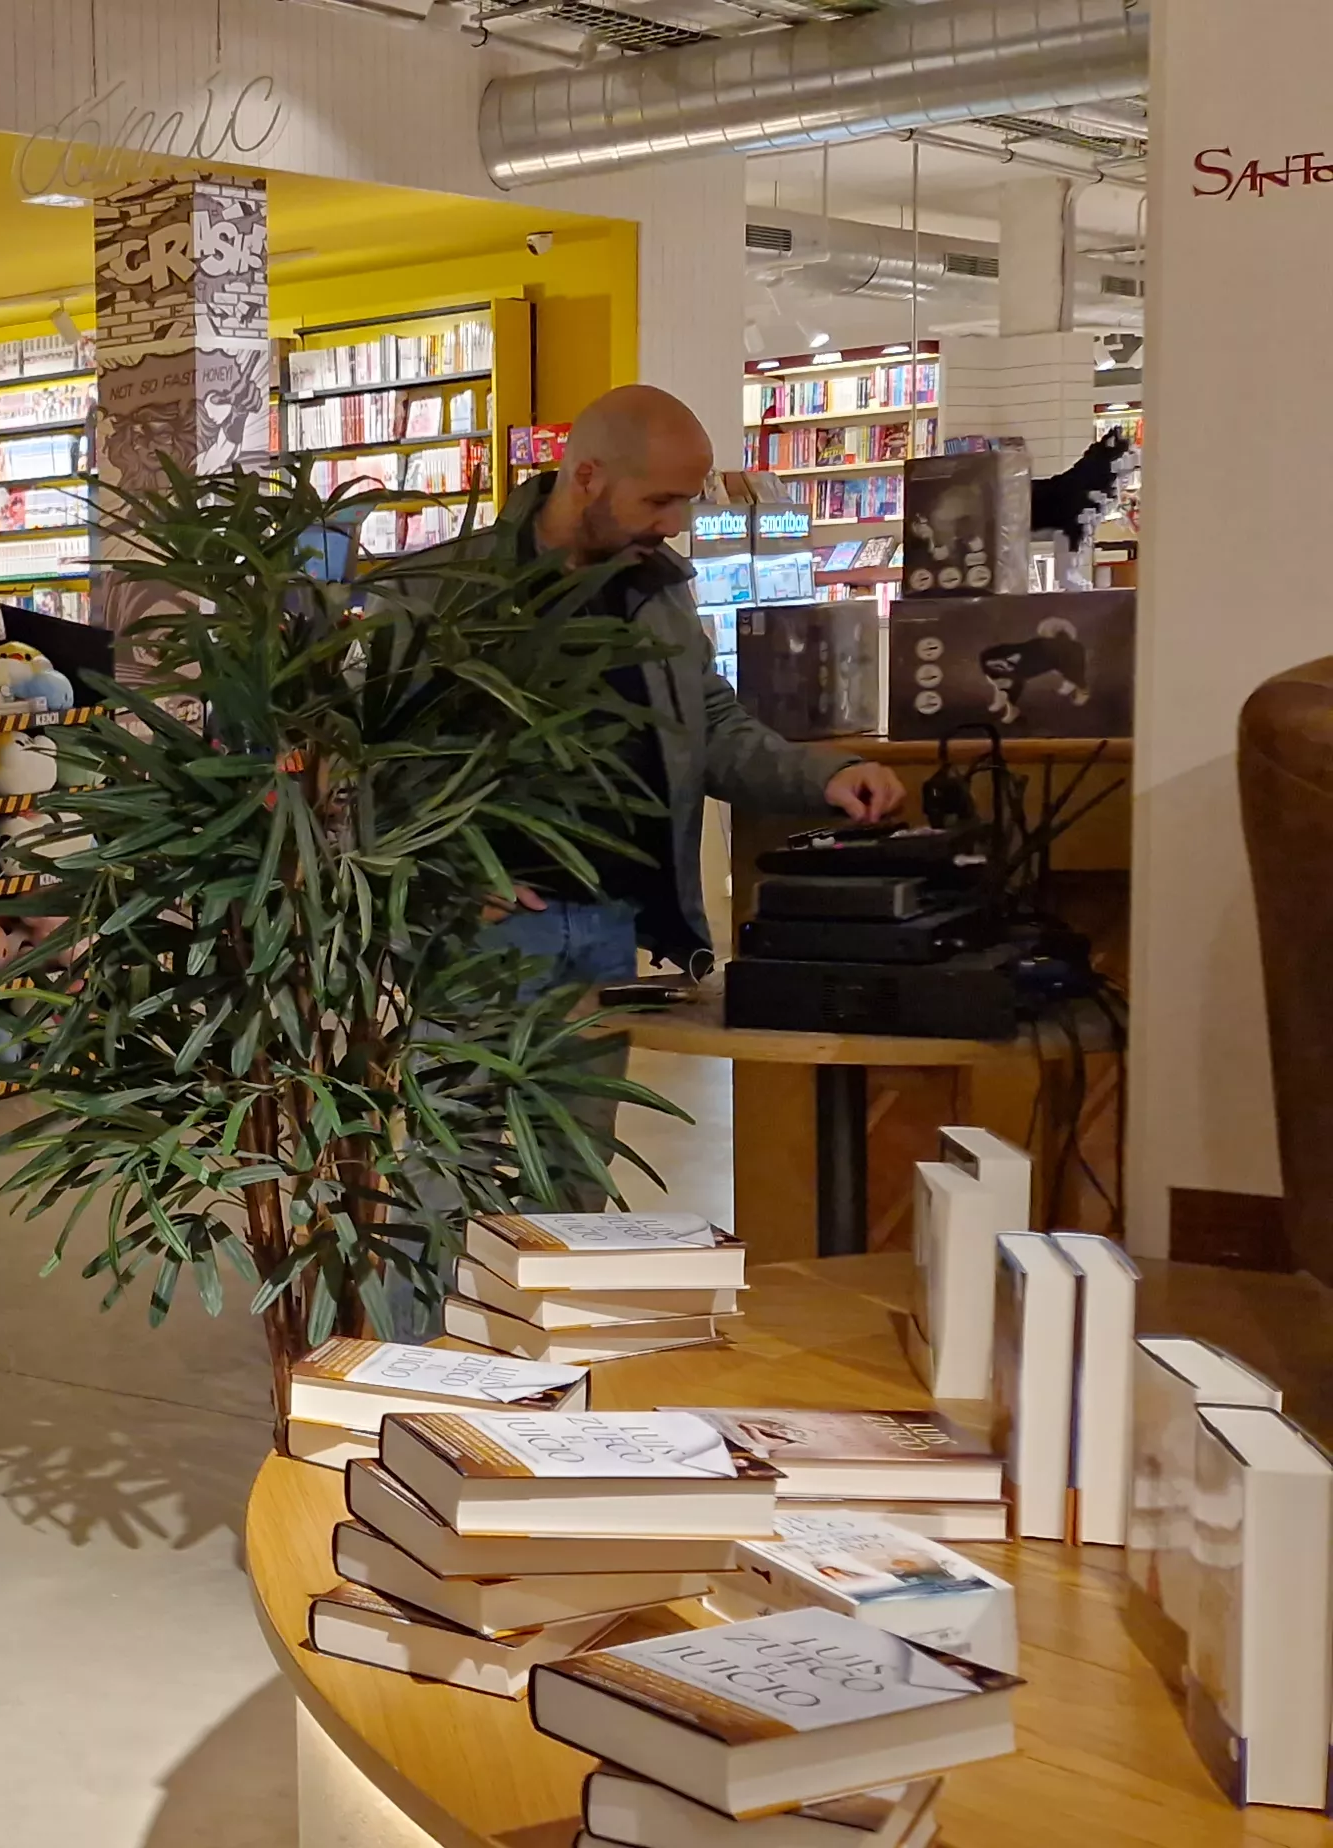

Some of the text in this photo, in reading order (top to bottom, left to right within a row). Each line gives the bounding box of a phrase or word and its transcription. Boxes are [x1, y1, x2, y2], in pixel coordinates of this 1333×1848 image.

[110, 384, 134, 401] NOT
[140, 380, 158, 396] SO
[162, 368, 197, 388] FAST
[695, 511, 747, 535] smartbox
[760, 510, 809, 533] smartbox
[35, 712, 60, 727] KENJI
[381, 1347, 436, 1378] JUICIO
[440, 1356, 492, 1387] ZUECO
[493, 1416, 585, 1463] JUICIO
[566, 1416, 654, 1463] ZUECO
[619, 1426, 686, 1456] LUIS
[861, 1415, 930, 1451] ZUECO
[903, 1423, 958, 1445] LUIS
[723, 1632, 885, 1692] ZUECO
[754, 1662, 789, 1676] EL
[789, 1637, 888, 1676] LUIS
[652, 1646, 821, 1707] JUICIO
